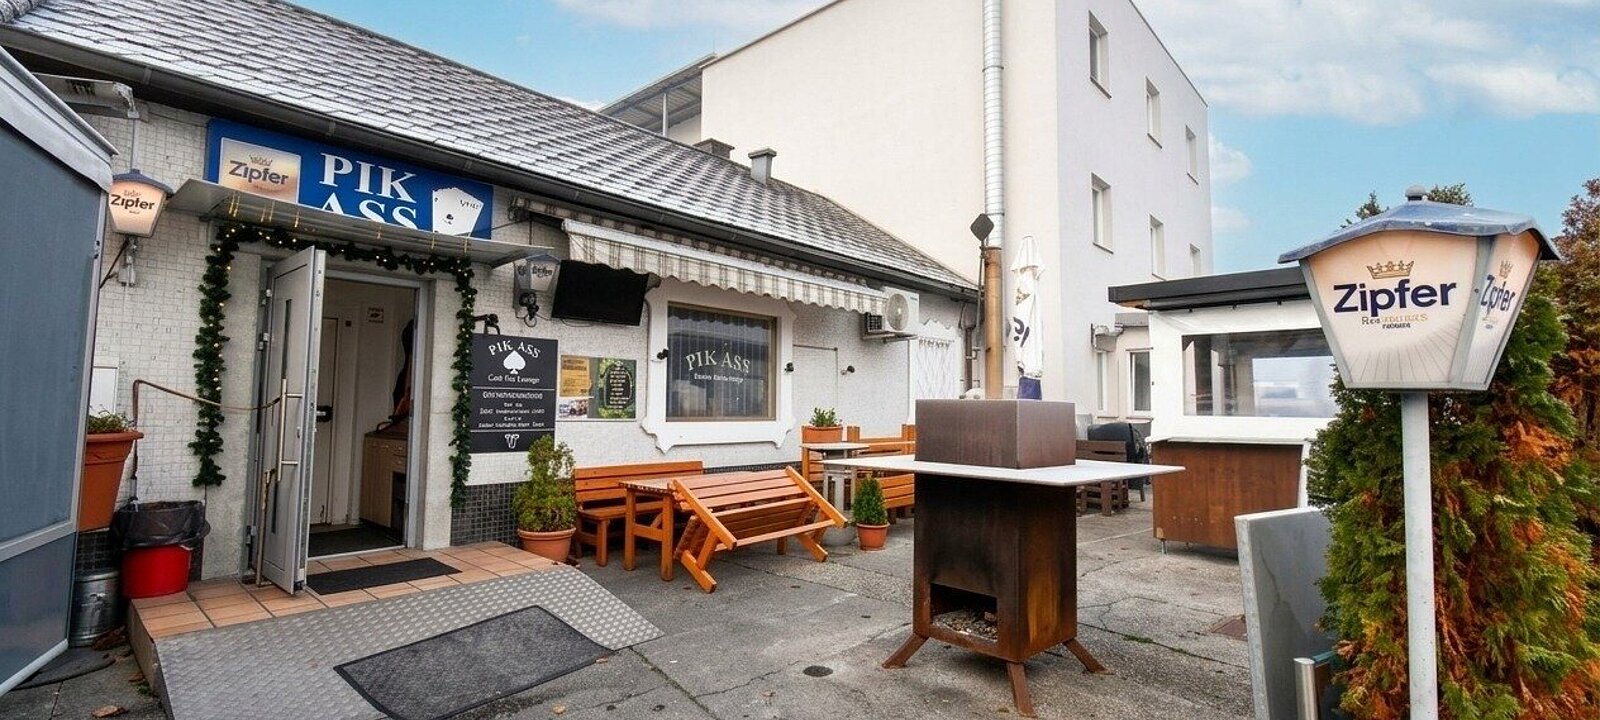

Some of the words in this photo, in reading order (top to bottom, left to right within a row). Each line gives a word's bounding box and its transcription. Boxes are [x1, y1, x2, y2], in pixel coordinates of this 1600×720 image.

[229, 160, 289, 185] Zipfer
[319, 152, 417, 203] PIK
[110, 194, 155, 210] Zipfer
[321, 192, 418, 230] ASS
[1333, 279, 1457, 317] Zipfer
[488, 340, 513, 356] PIK
[517, 341, 541, 358] ASS
[686, 350, 717, 371] PIK
[721, 351, 750, 373] ASS
